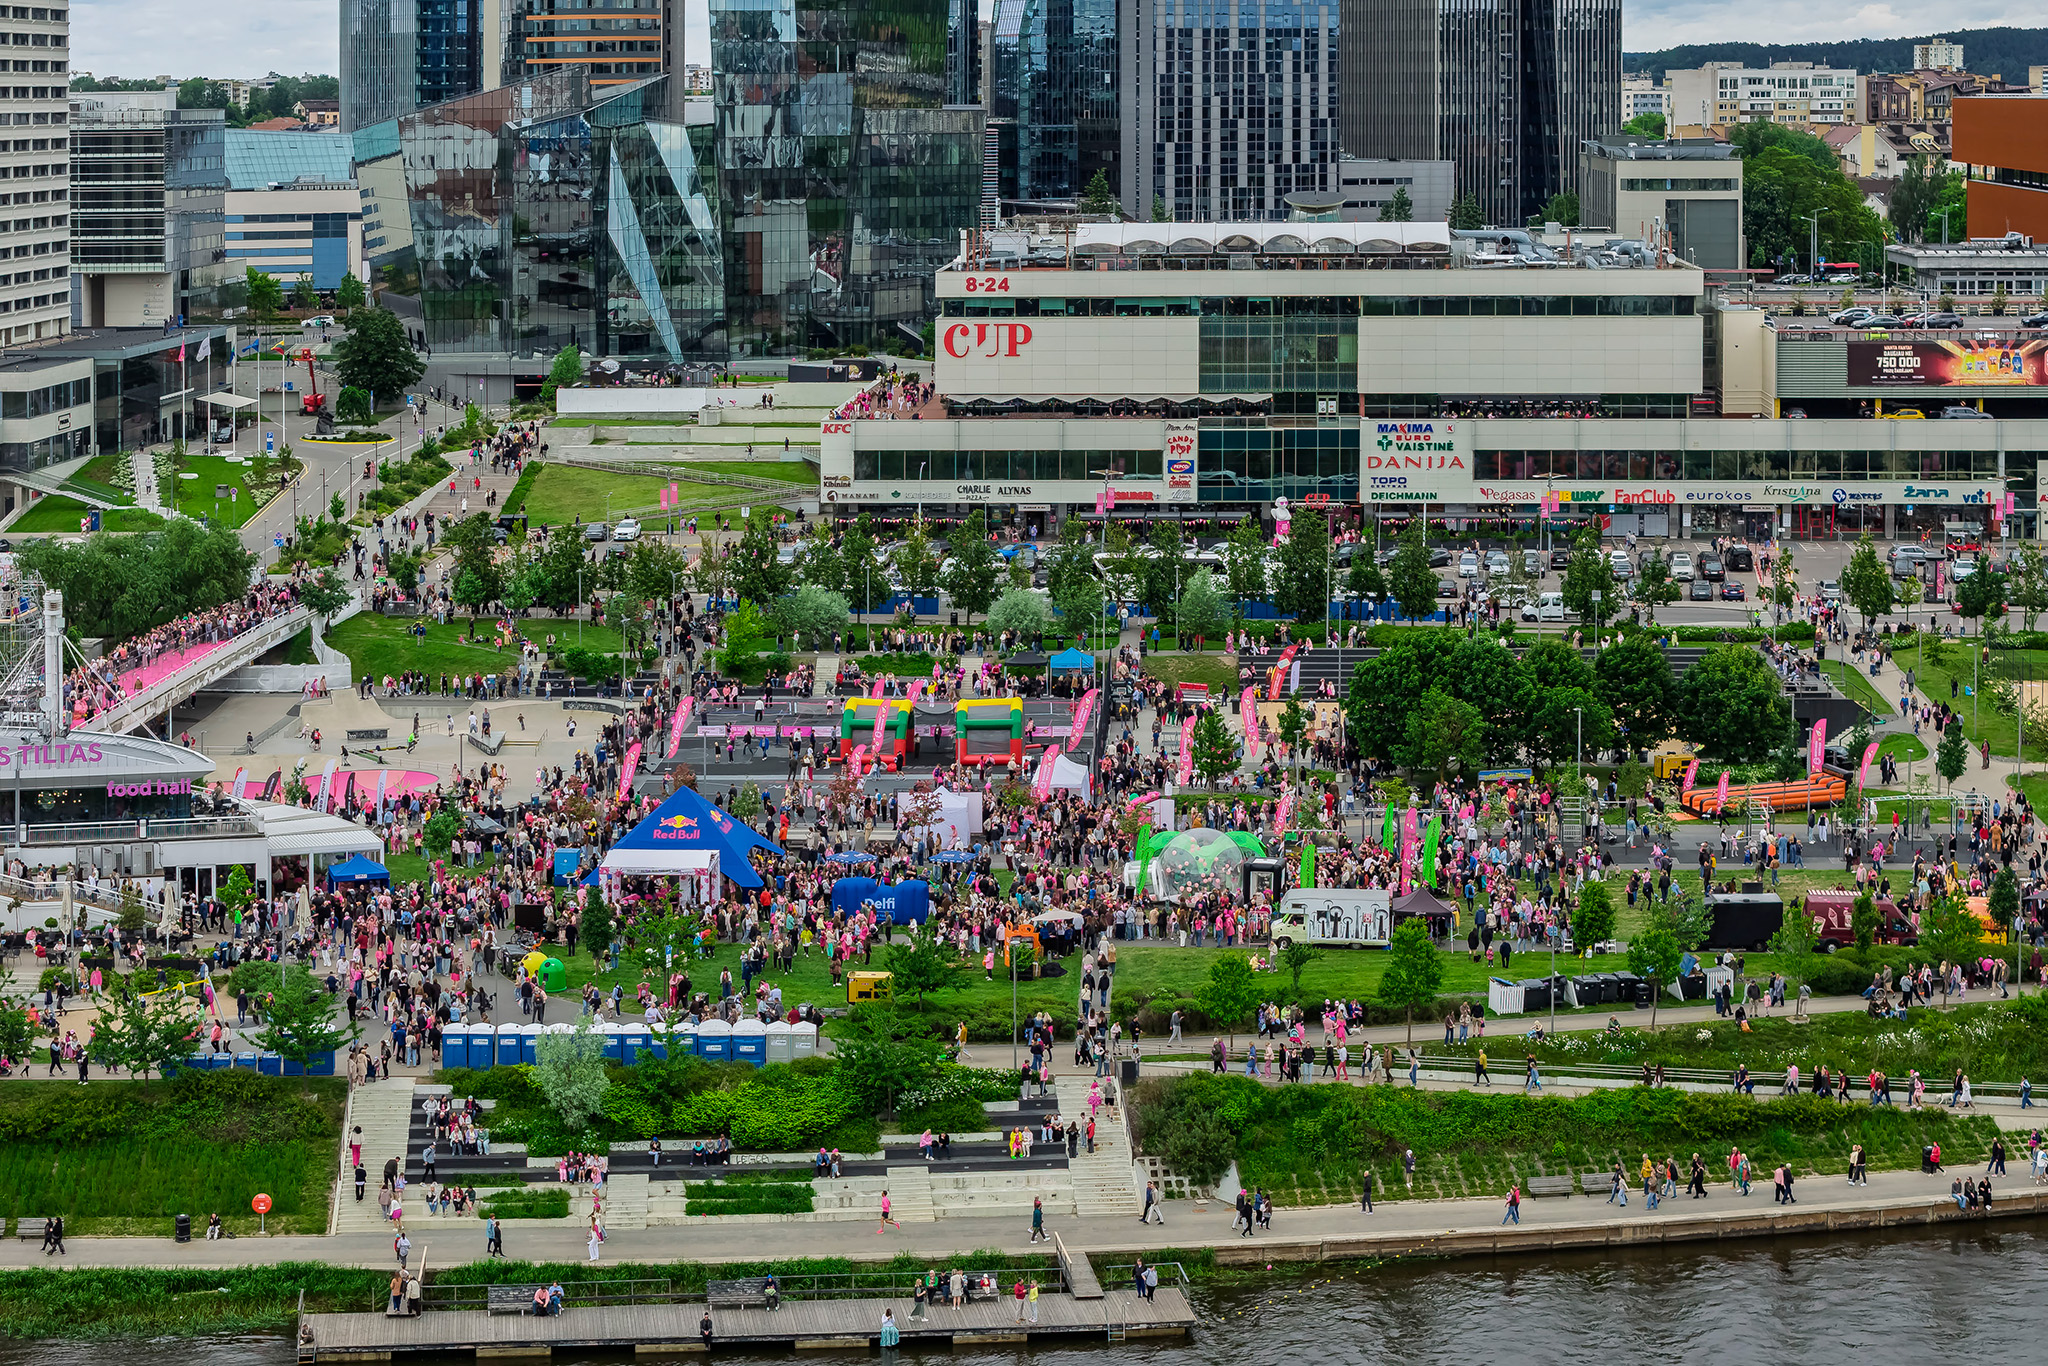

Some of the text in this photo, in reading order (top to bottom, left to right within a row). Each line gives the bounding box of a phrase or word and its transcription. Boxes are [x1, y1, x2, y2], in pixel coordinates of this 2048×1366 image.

[965, 276, 1010, 293] 8-24
[943, 323, 1033, 359] CUP
[1876, 356, 1921, 368] 750 000
[822, 423, 852, 434] KFC
[1377, 422, 1434, 435] MAXIMA
[1167, 435, 1195, 445] CANDY
[1395, 434, 1432, 442] EURO
[1395, 440, 1455, 452] VAISTINĖ
[1366, 455, 1466, 470] DANIJA
[1370, 476, 1408, 485] TOPO
[956, 484, 992, 495] CHARLIE
[997, 486, 1032, 496] ALYNAS
[1370, 491, 1438, 500] DEICHMANN
[1485, 488, 1537, 503] Pegasas
[1686, 490, 1752, 501] eurokos
[1614, 489, 1676, 504] FamClub
[17, 742, 103, 765] TILTAS
[106, 777, 192, 798] food hall
[653, 828, 701, 840] Red Bull
[864, 897, 896, 910] Delfi
